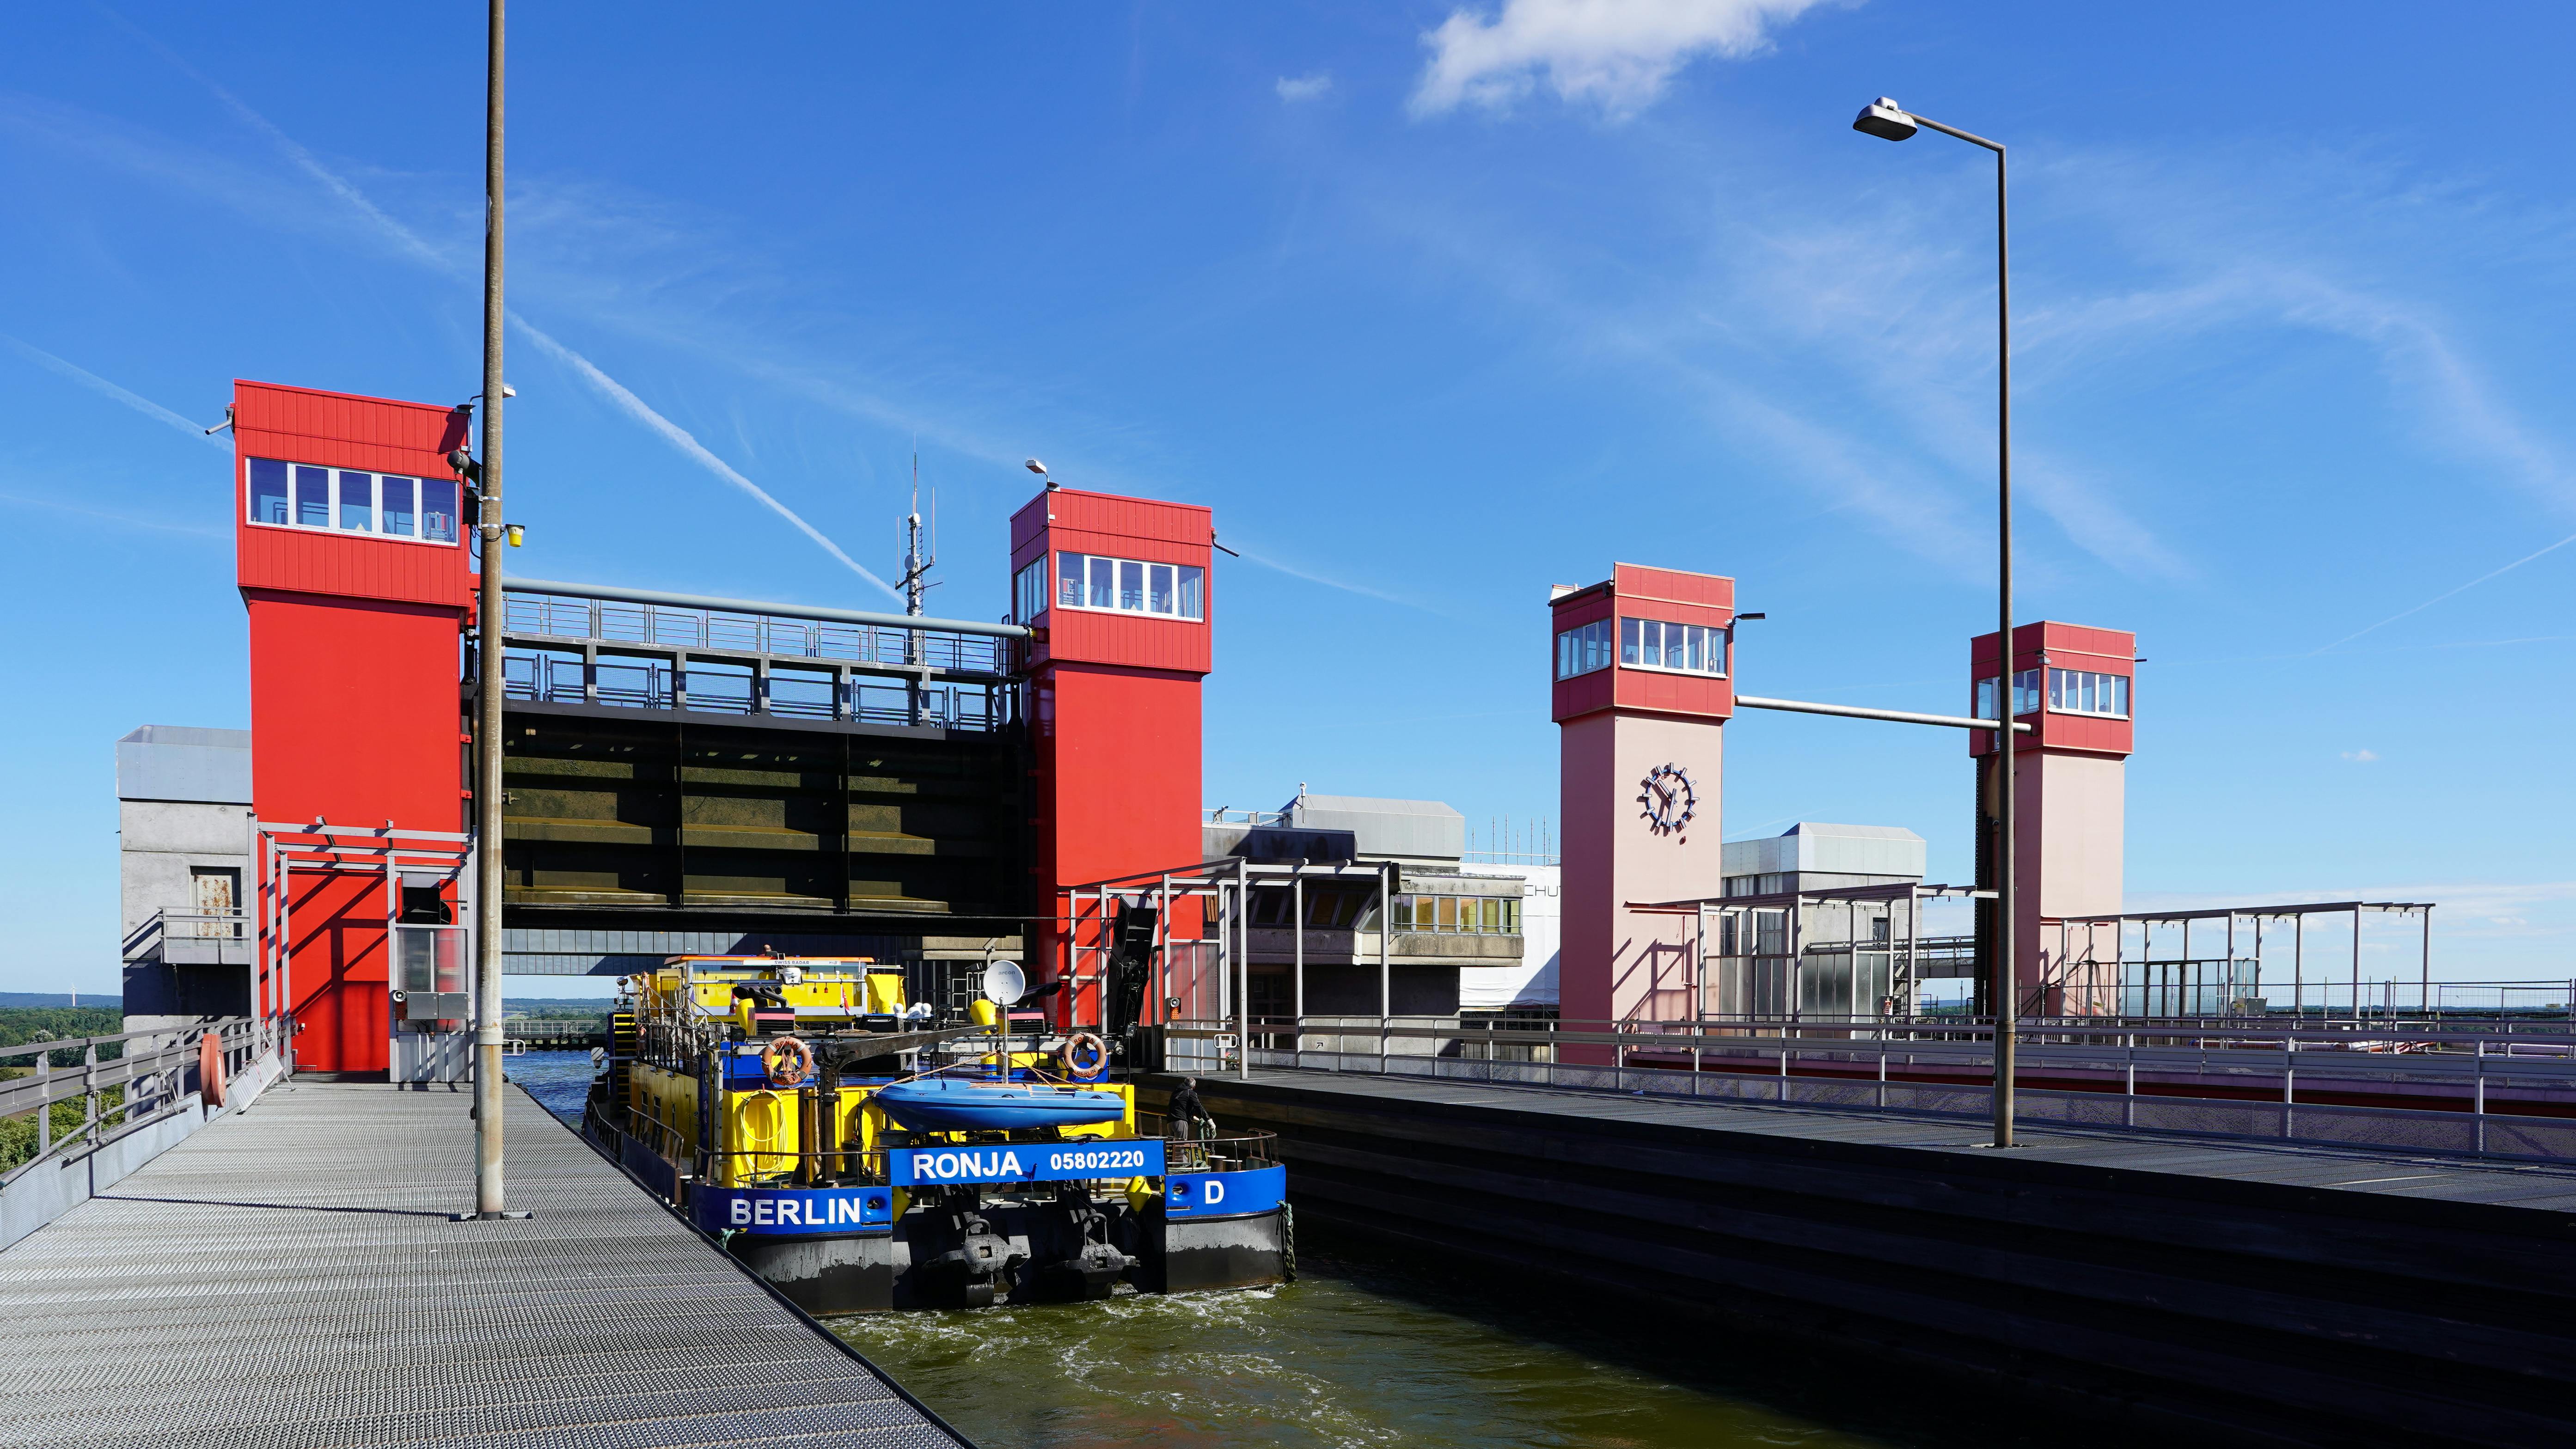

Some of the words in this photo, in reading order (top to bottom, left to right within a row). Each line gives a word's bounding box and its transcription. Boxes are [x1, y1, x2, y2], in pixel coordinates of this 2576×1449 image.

[1524, 885, 1561, 897] CHU
[913, 1151, 1023, 1179] RONJA
[1050, 1150, 1144, 1170] 05802220
[1205, 1180, 1224, 1204] D
[731, 1198, 860, 1225] BERLIN
